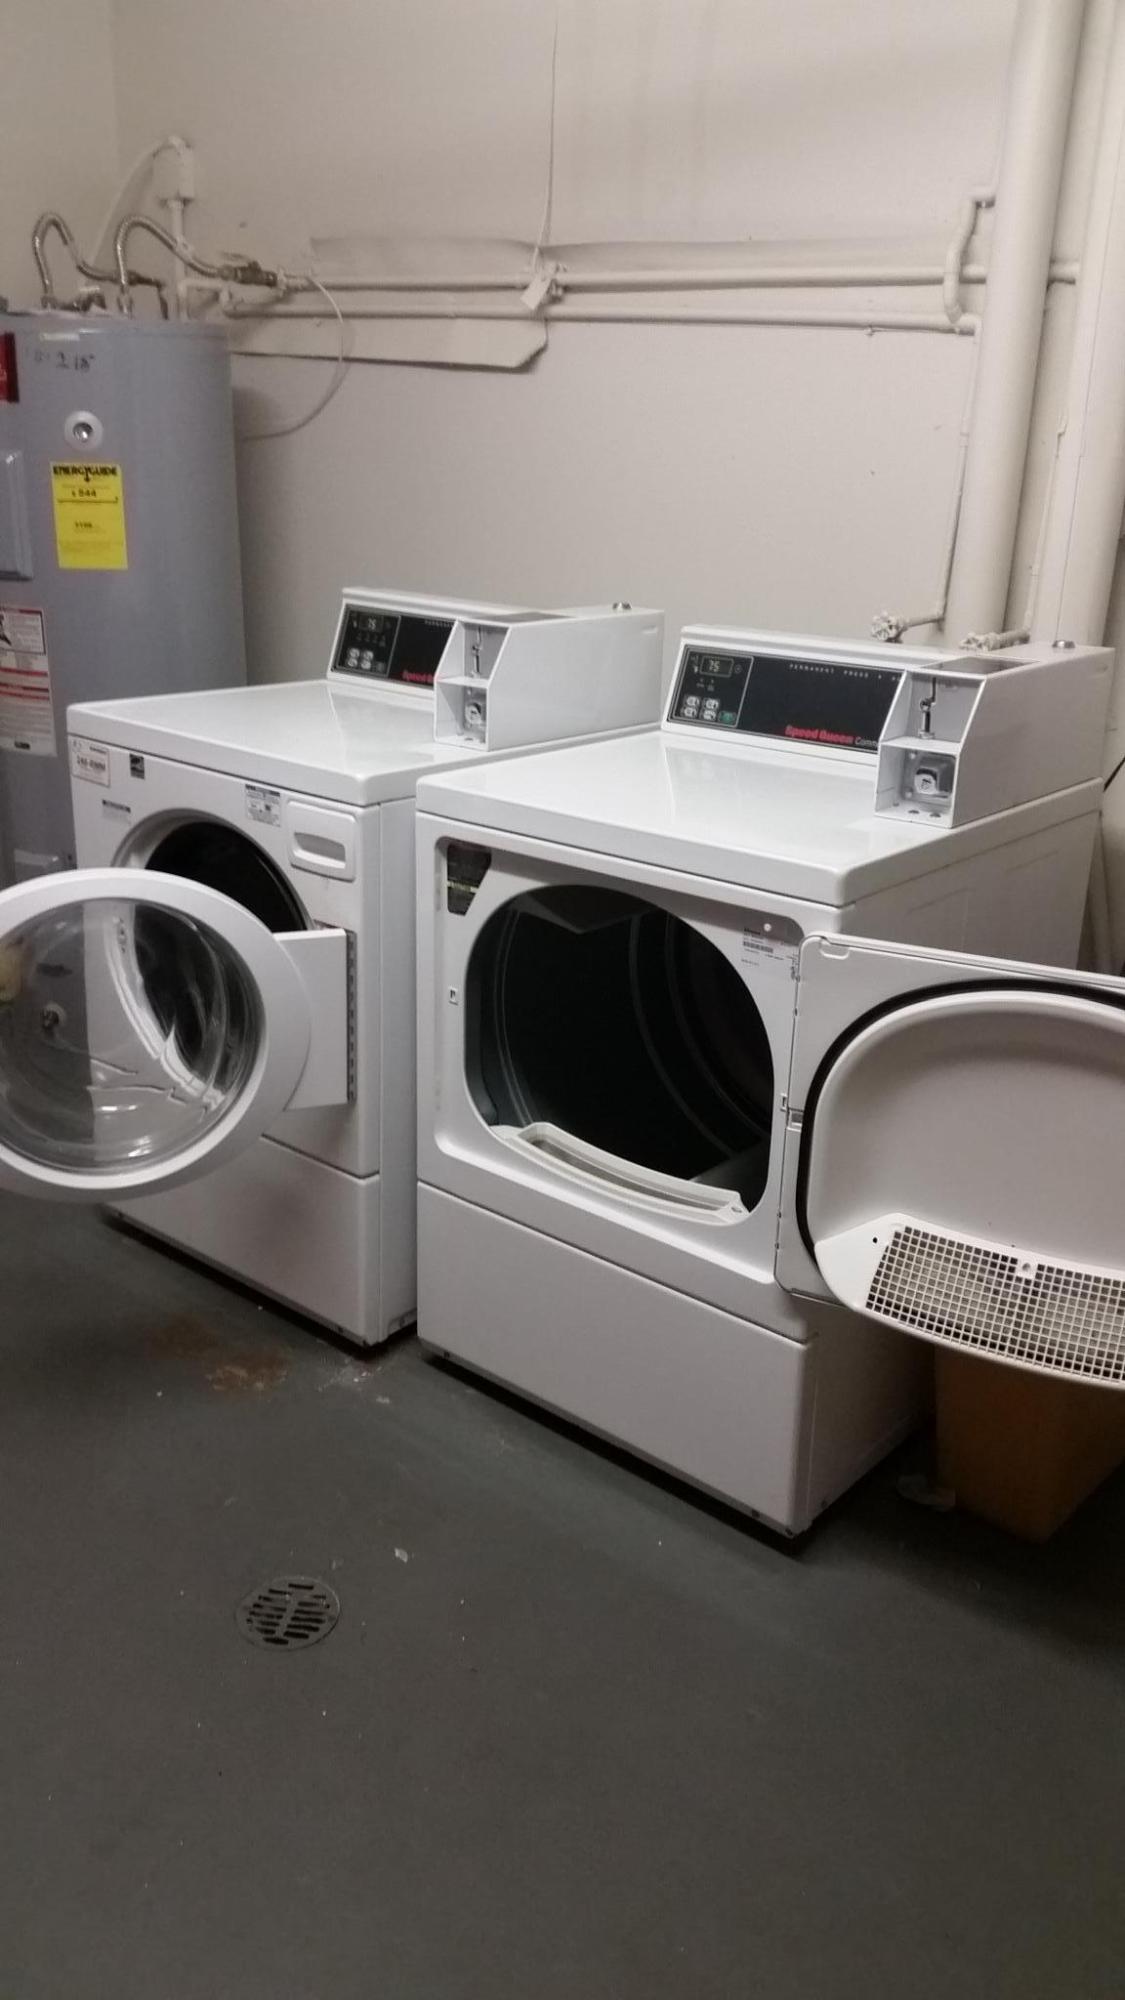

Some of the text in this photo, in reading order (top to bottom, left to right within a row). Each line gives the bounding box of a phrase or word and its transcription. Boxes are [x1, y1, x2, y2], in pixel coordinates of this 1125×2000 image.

[53, 466, 117, 476] ENERGYGUIDE
[709, 659, 720, 673] 75
[402, 670, 427, 683] Speed
[785, 725, 819, 738] Speed
[819, 730, 855, 744] Queen
